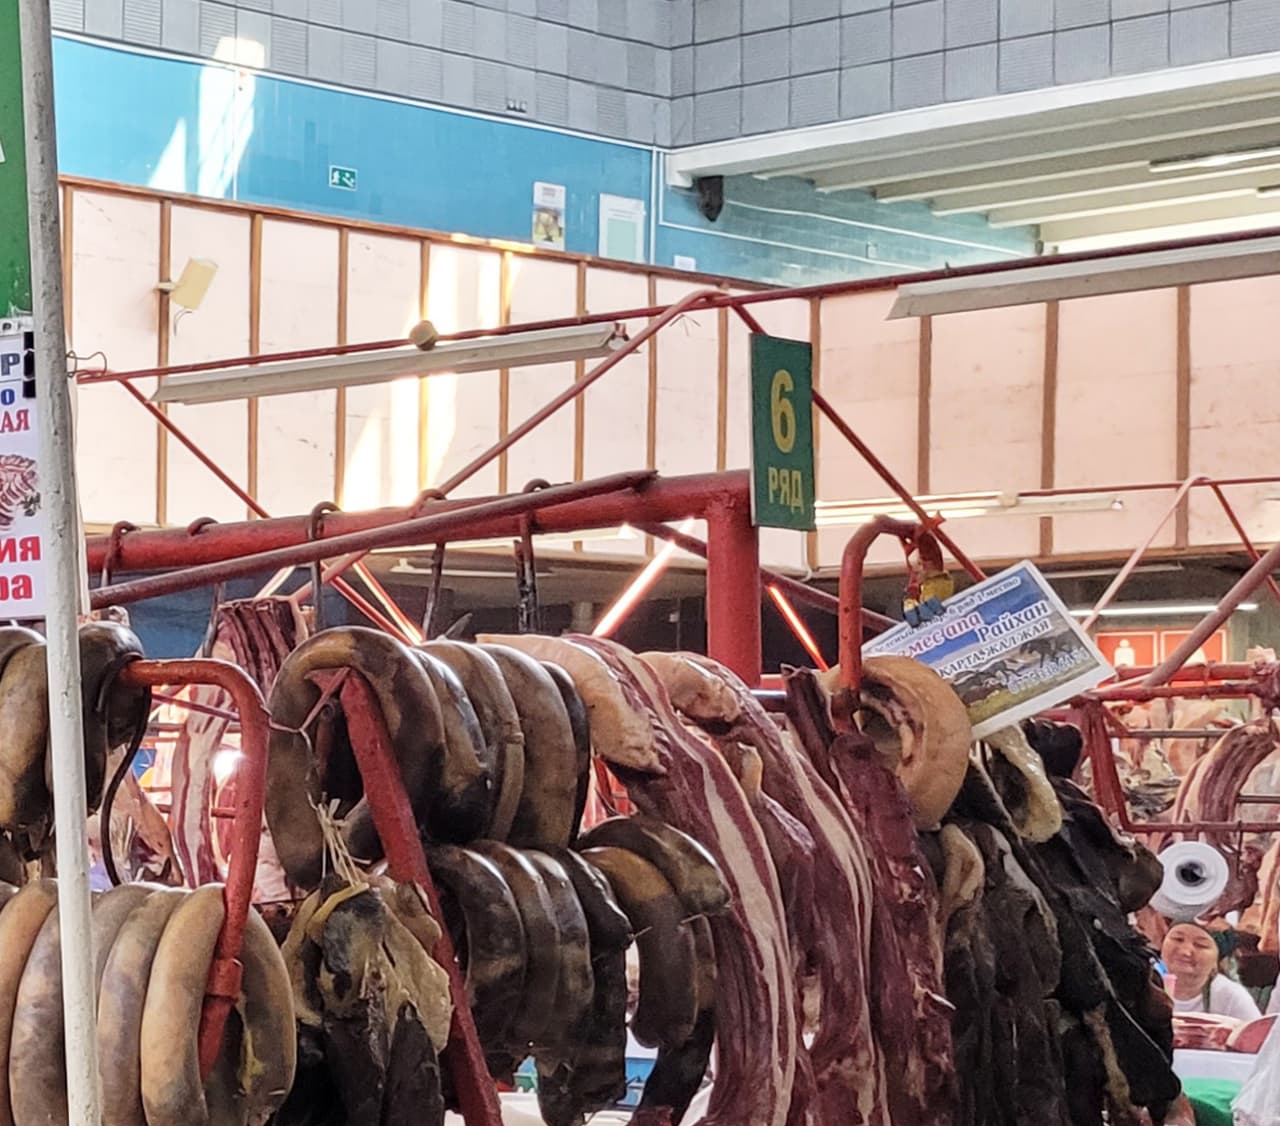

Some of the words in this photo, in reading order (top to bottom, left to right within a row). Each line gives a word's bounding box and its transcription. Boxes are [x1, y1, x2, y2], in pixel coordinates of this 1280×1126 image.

[769, 368, 795, 454] 6
[768, 465, 805, 516] РЯД
[976, 600, 1049, 643] Райхан
